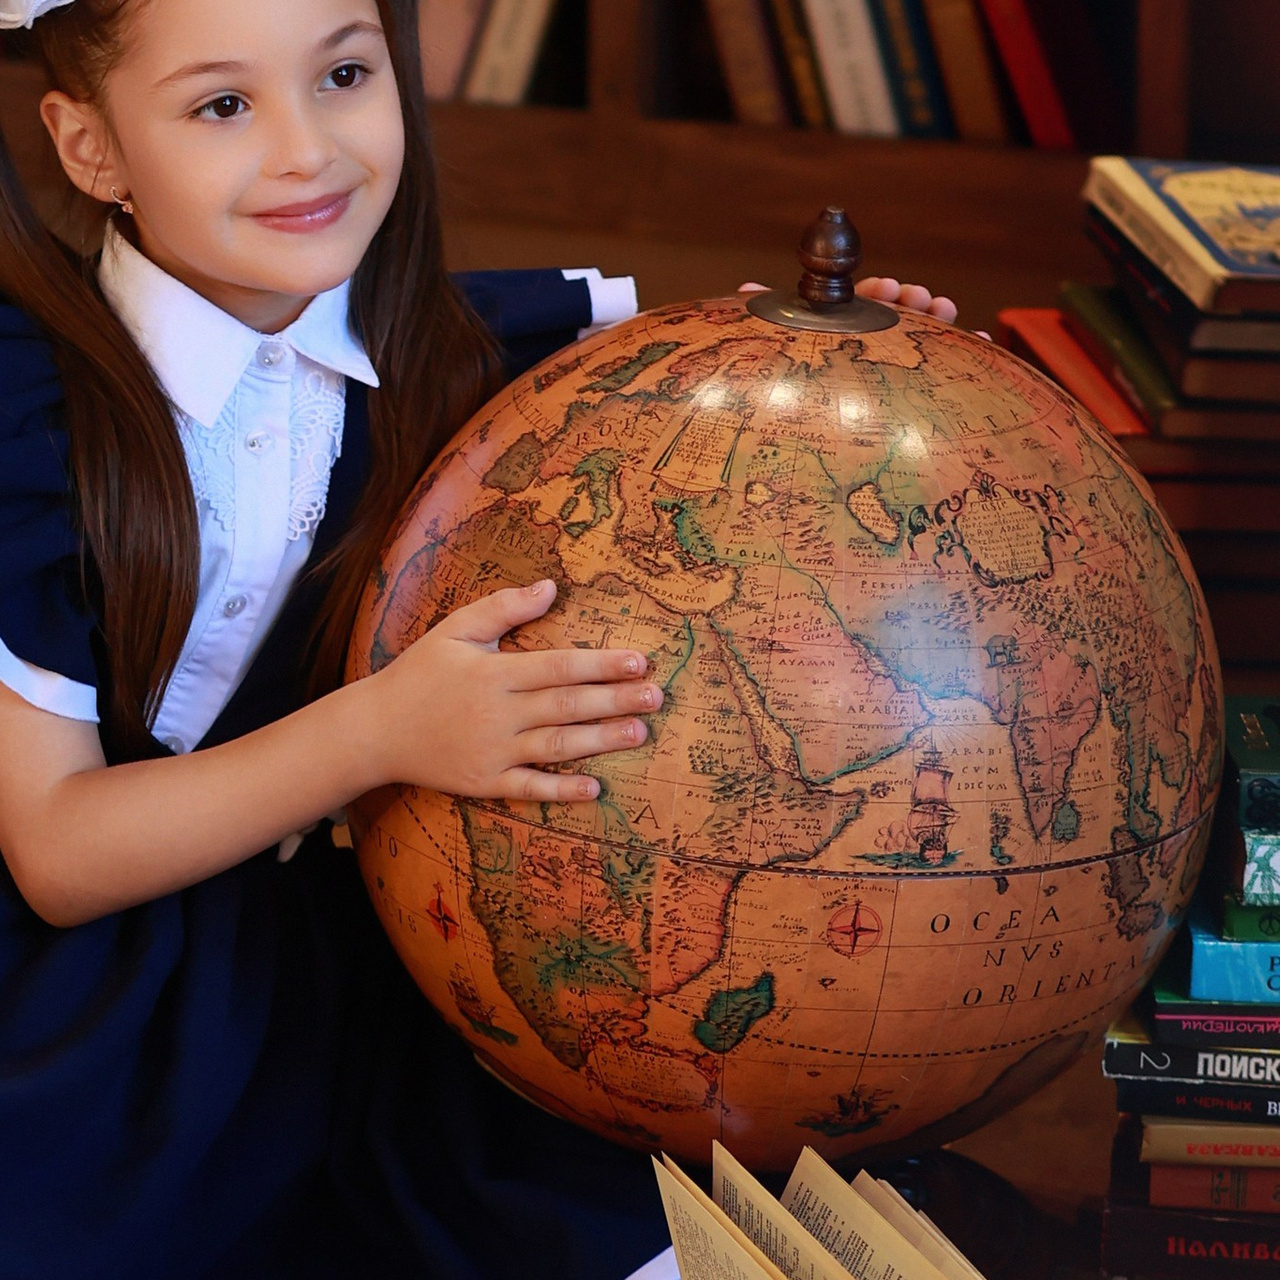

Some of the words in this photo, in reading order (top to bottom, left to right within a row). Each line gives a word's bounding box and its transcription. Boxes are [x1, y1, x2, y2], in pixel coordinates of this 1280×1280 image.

[861, 580, 915, 590] PERSIA
[778, 659, 836, 668] AYAMAN
[846, 704, 909, 715] ARABIA
[930, 905, 1060, 933] OCEA
[983, 939, 1064, 967] NVS
[1139, 1050, 1172, 1071] 2
[1196, 1051, 1280, 1083] ПОИСК
